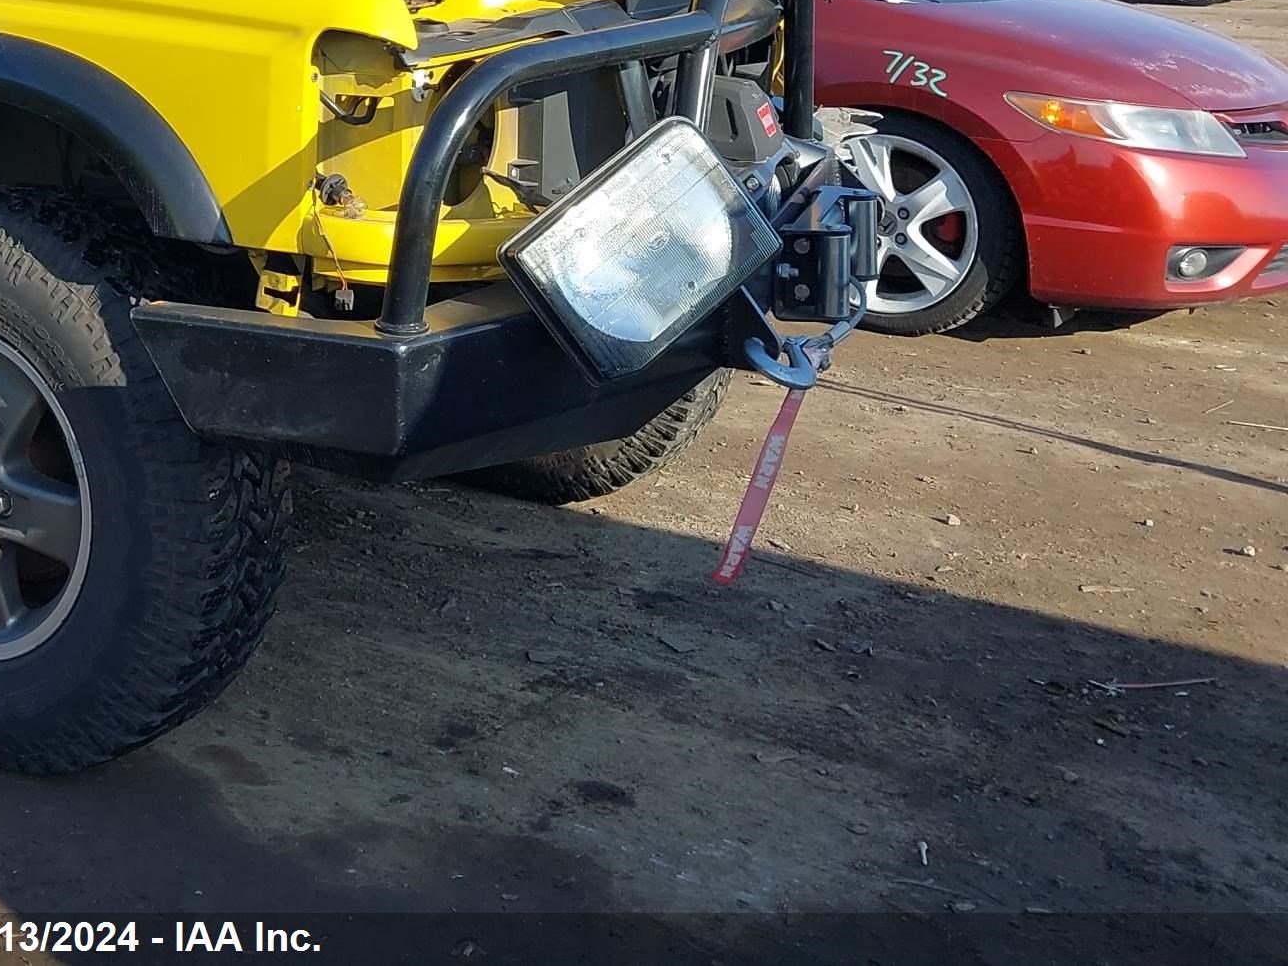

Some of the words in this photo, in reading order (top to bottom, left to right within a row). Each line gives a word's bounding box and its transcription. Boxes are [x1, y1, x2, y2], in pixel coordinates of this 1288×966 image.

[883, 49, 948, 98] 7/32
[754, 433, 787, 490] WARN
[719, 524, 754, 577] WARN
